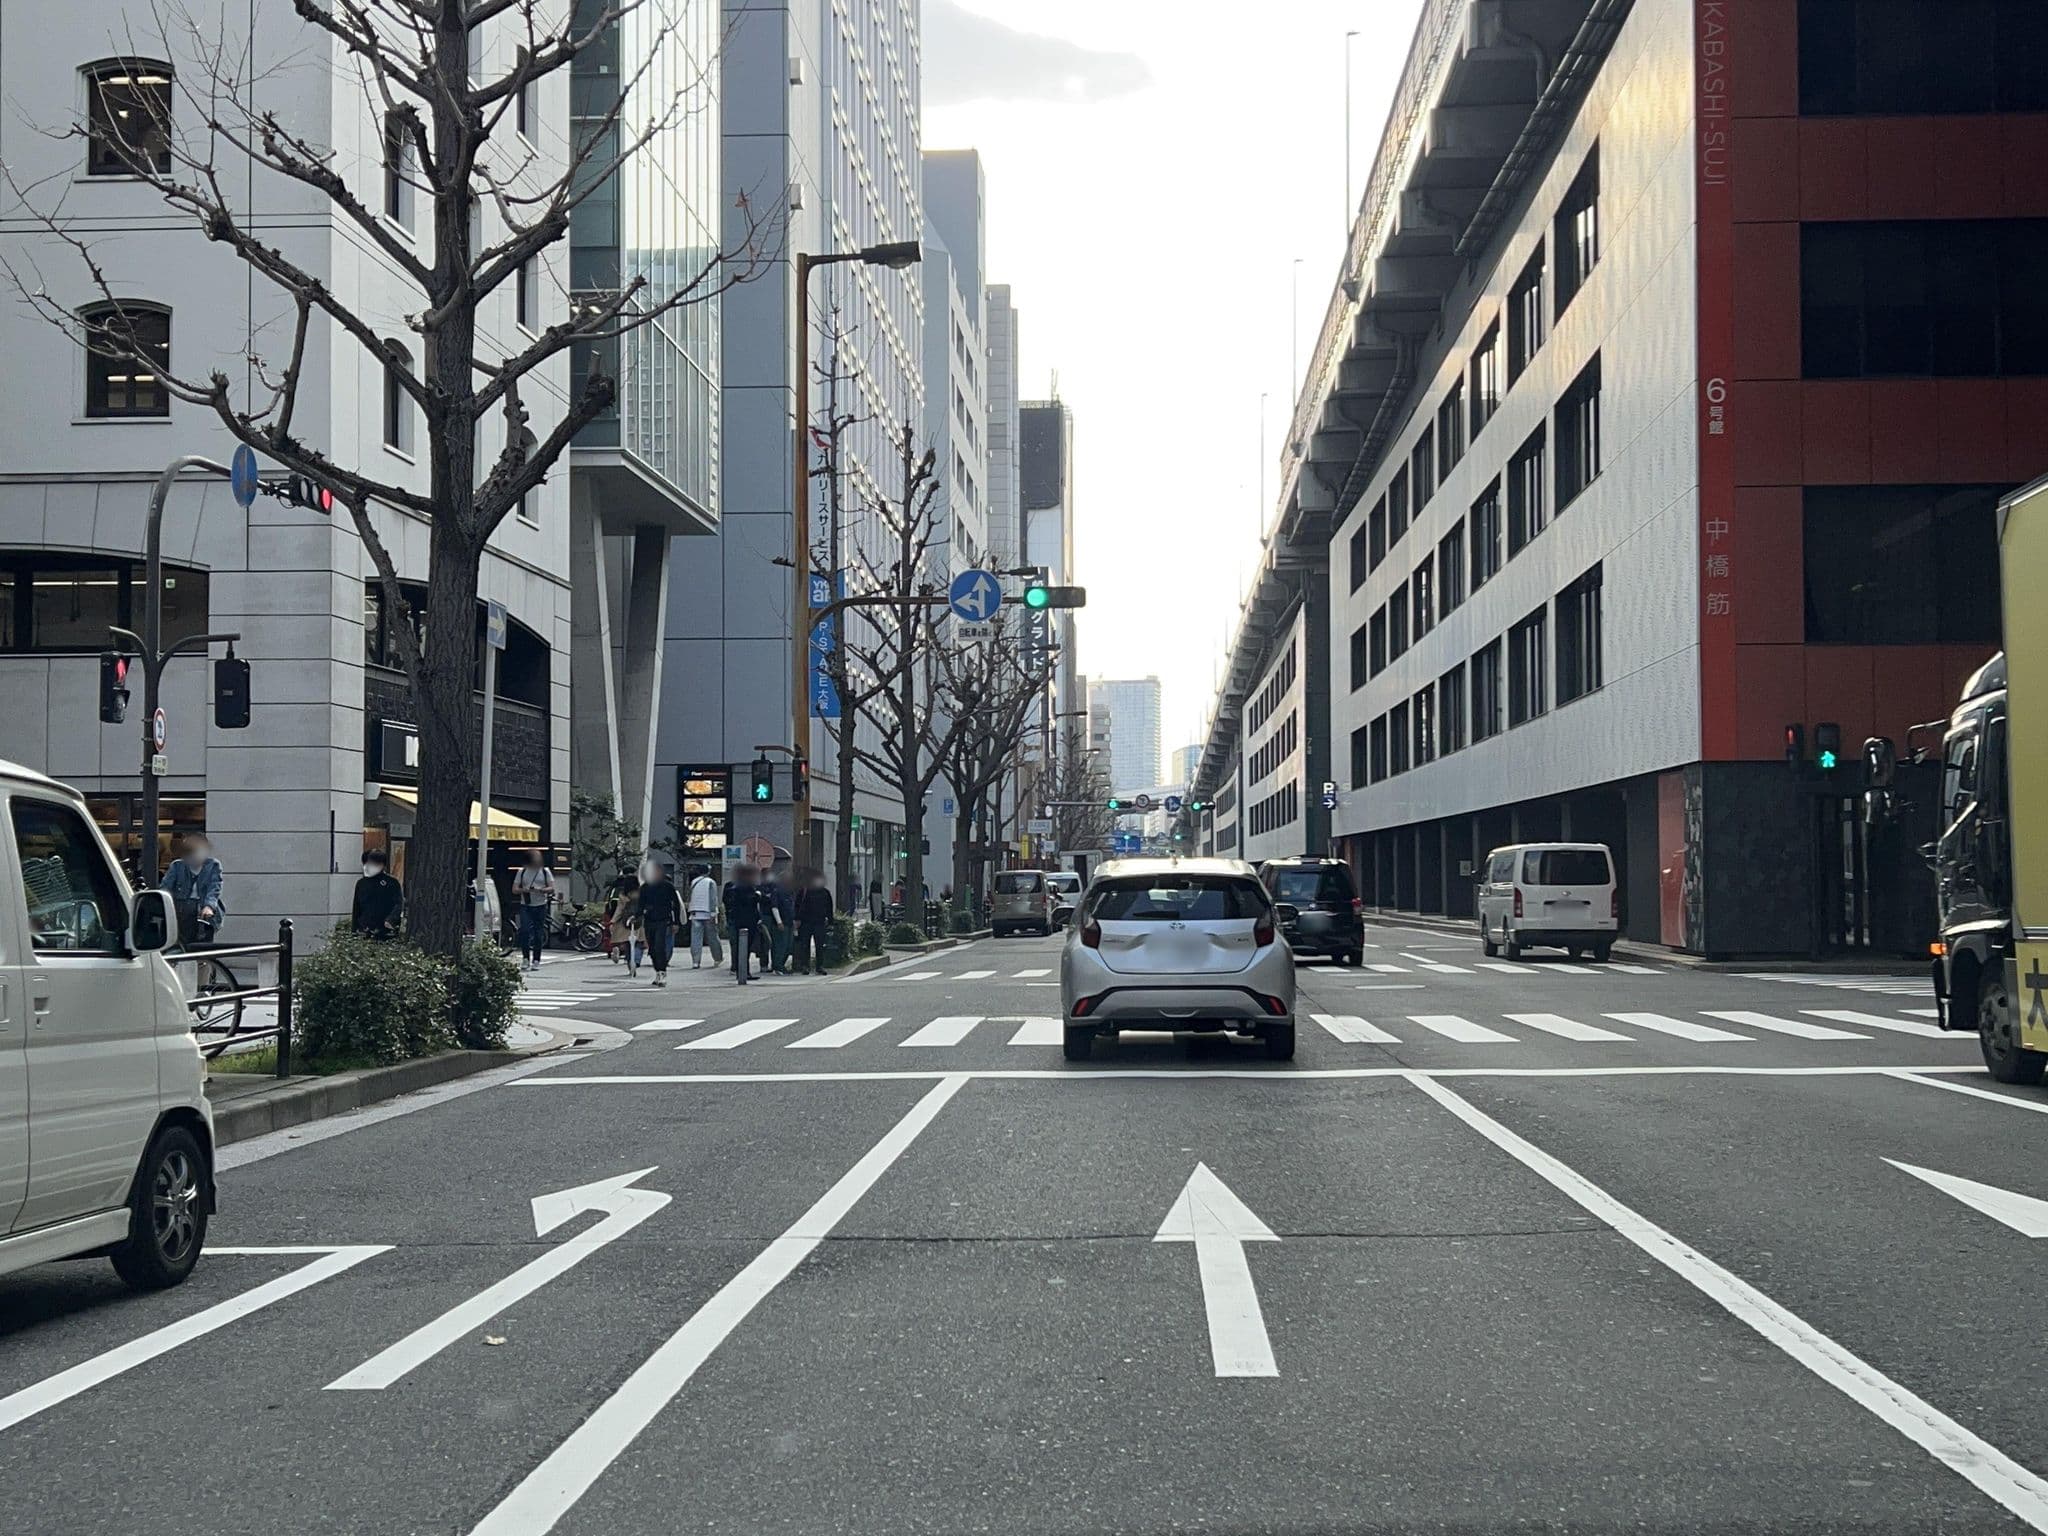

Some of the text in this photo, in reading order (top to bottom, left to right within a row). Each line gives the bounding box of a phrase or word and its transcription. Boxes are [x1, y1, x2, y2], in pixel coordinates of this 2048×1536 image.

[1706, 377, 1727, 435] 6号館
[1706, 517, 1729, 615] 中橋筋
